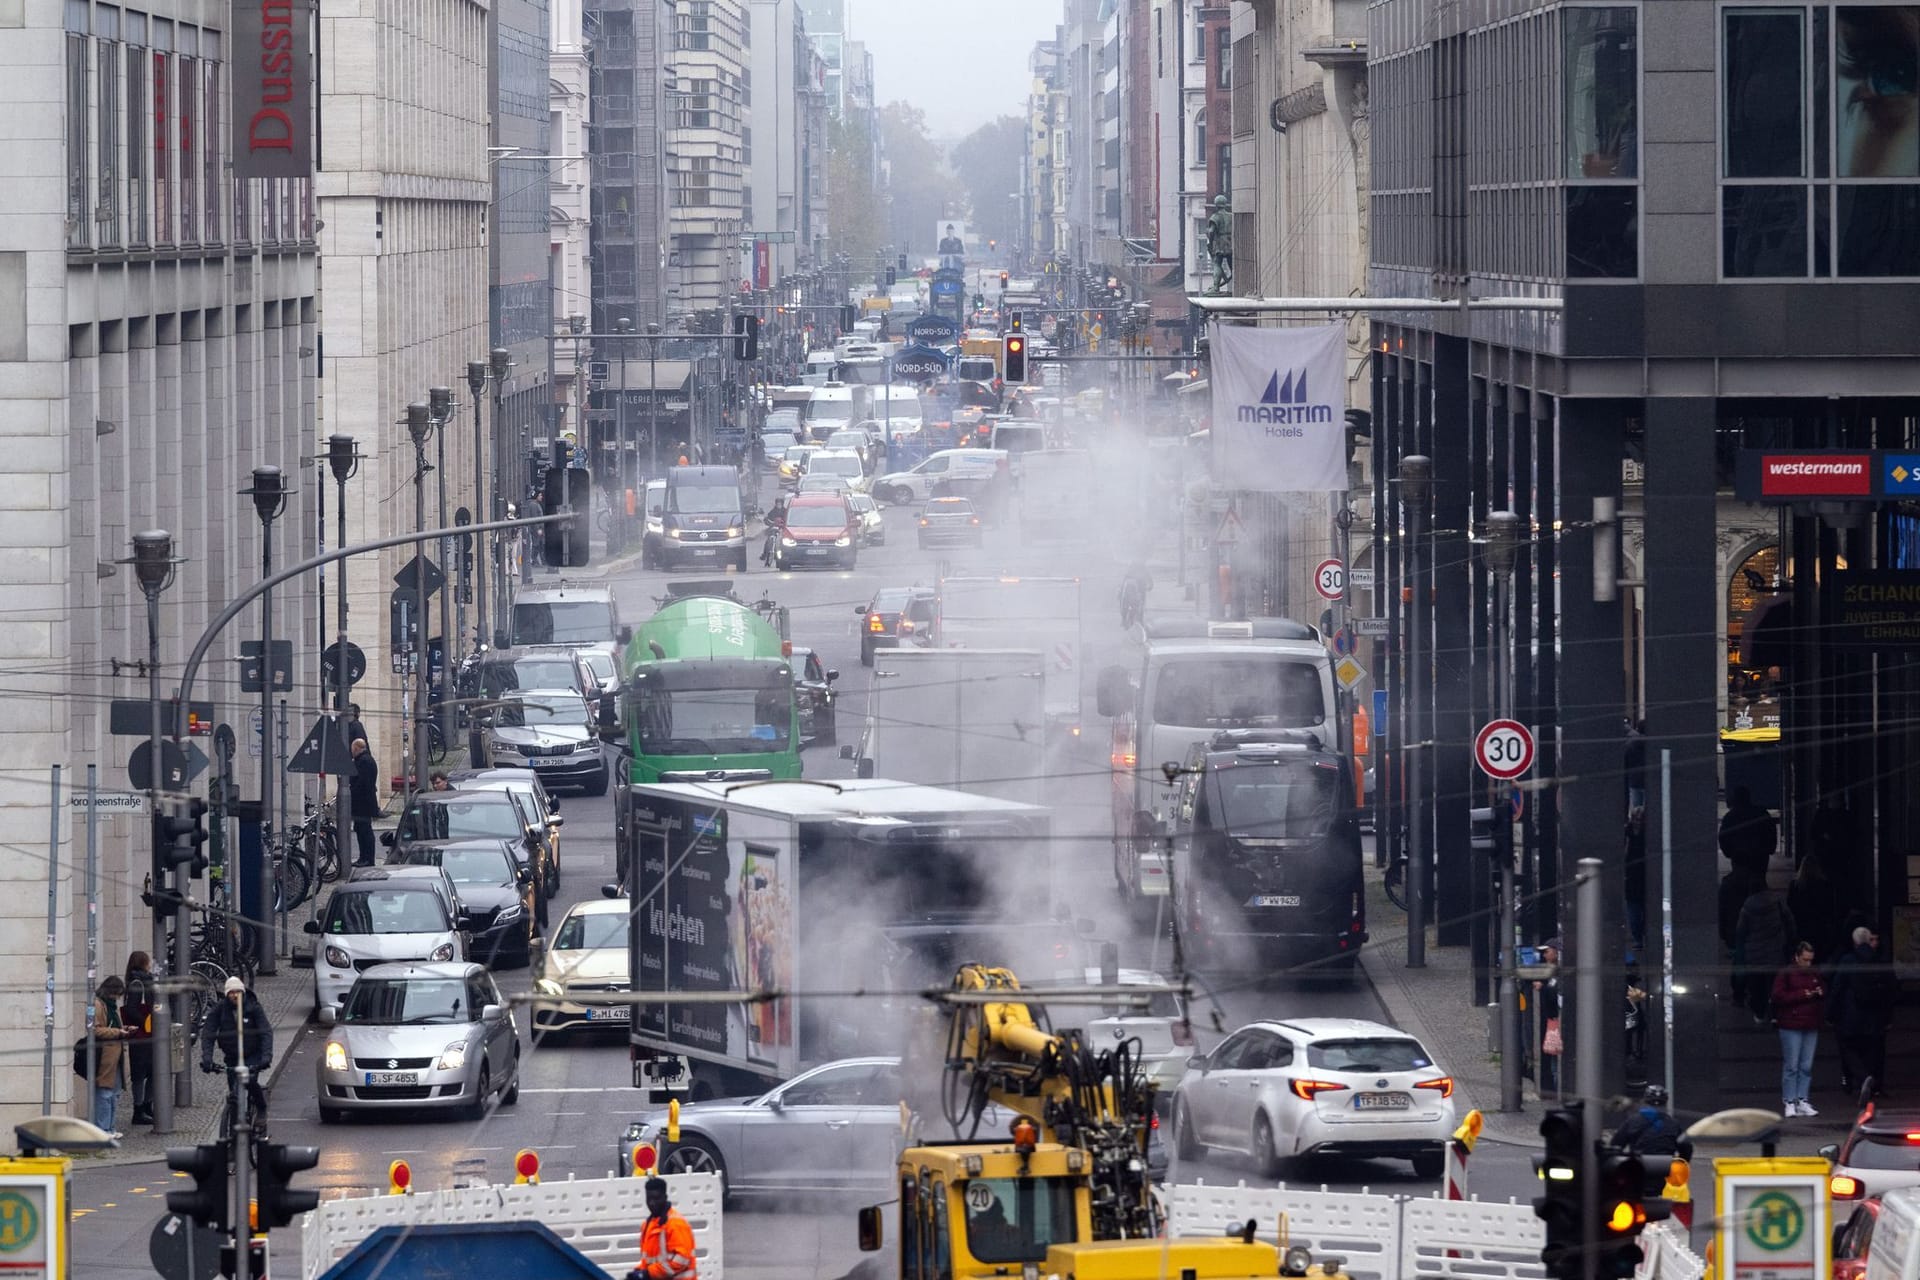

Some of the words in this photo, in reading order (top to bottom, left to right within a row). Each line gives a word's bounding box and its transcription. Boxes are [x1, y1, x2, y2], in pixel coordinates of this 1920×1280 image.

[914, 327, 951, 336] NORD-SÜD
[895, 362, 943, 374] NORD-SÜD
[1238, 405, 1332, 424] MARITIM
[1265, 427, 1304, 438] Hotels
[1770, 461, 1862, 475] westermann
[1322, 570, 1342, 588] 30
[1489, 736, 1521, 762] 30
[650, 898, 705, 946] kuchen
[382, 1074, 394, 1083] SF
[1360, 1096, 1373, 1106] TF
[1391, 1095, 1407, 1106] 502
[970, 1189, 989, 1207] 20
